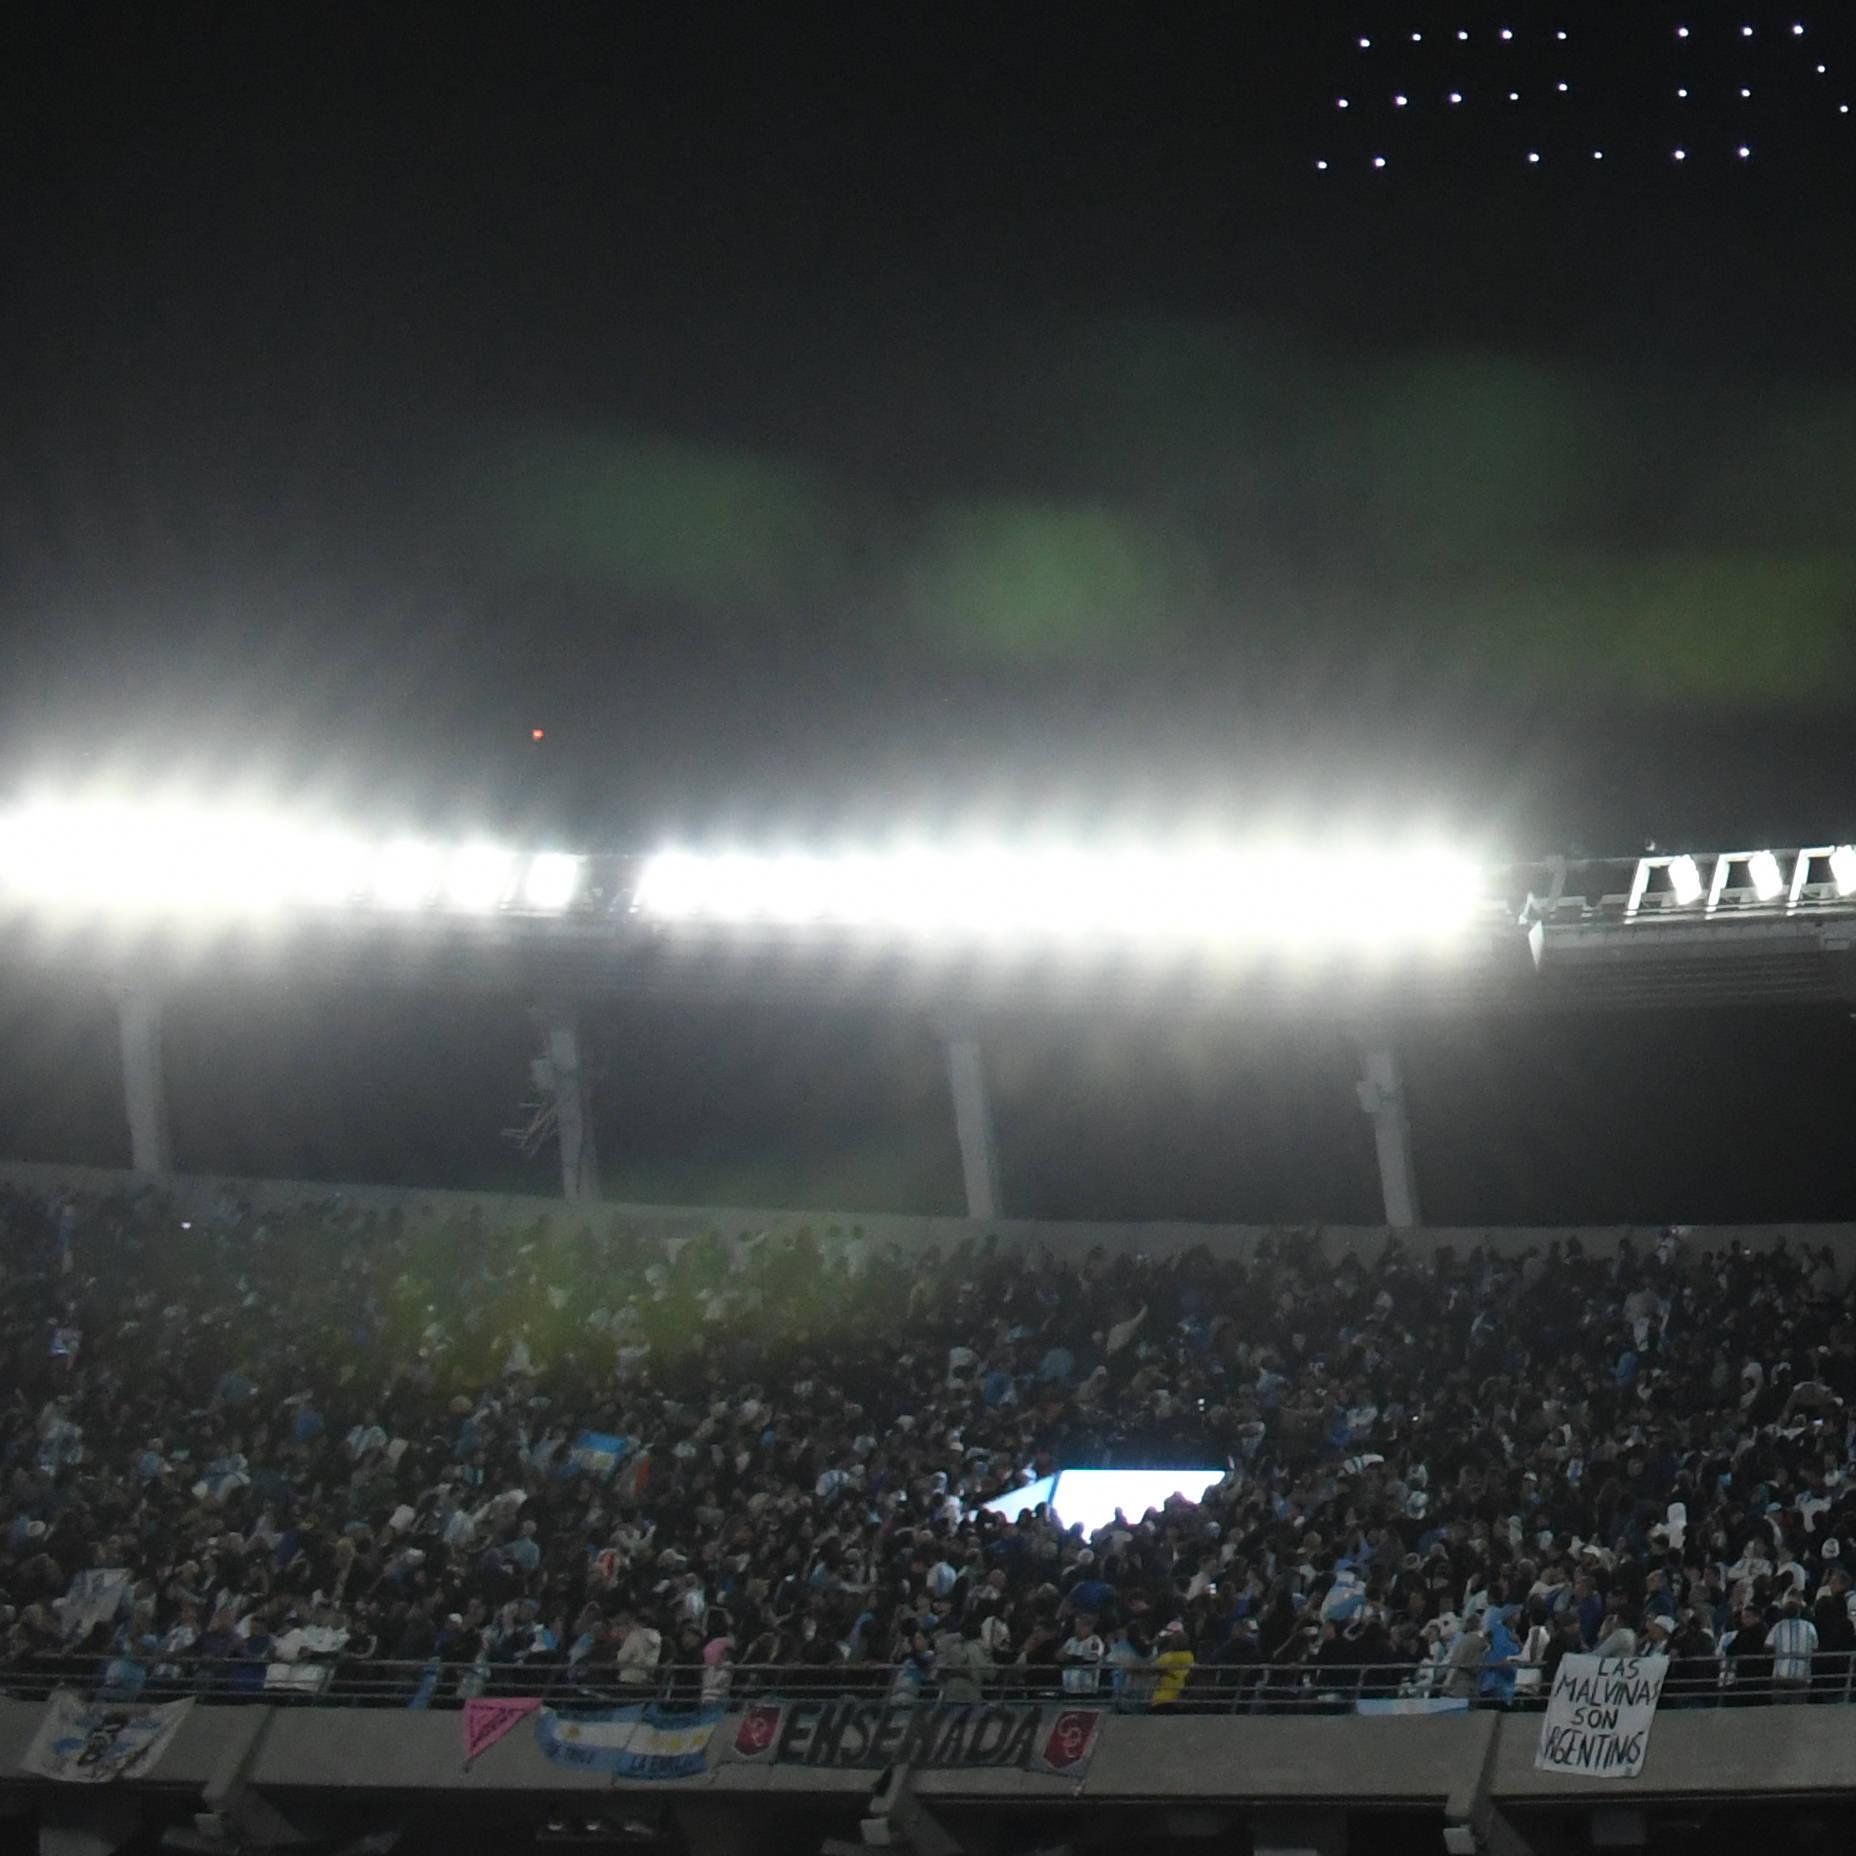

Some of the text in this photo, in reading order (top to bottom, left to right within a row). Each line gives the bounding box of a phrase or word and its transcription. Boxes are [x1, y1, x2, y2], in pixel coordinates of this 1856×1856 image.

[1598, 1658, 1640, 1679] LAS
[1554, 1674, 1661, 1707] MALVINAS
[1571, 1706, 1619, 1730] SON
[778, 1700, 1042, 1767] ENSENADA
